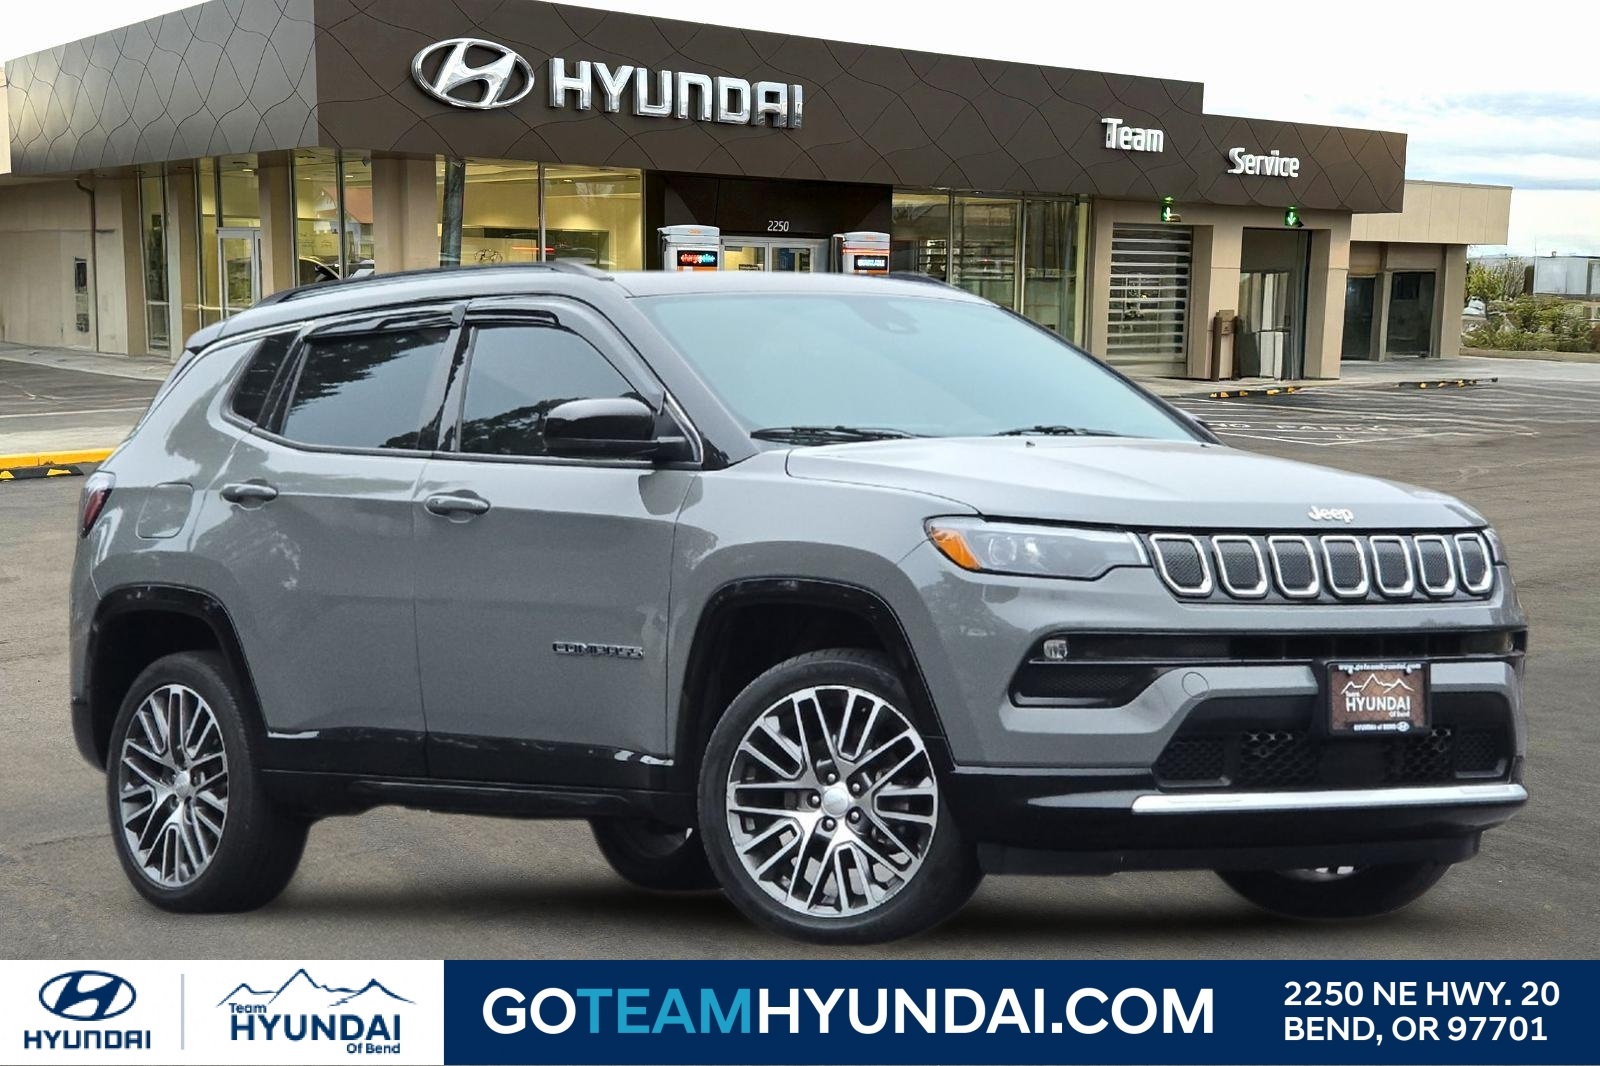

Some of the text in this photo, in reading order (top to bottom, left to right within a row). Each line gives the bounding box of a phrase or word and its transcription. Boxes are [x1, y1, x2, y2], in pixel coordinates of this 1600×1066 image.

[549, 57, 803, 129] HYUNDAI
[1101, 117, 1164, 152] Team
[1227, 147, 1300, 178] Service
[767, 220, 790, 232] 2250
[1307, 505, 1354, 524] Jeep
[552, 641, 644, 659] COMPASS
[1345, 696, 1411, 712] HYUNDAI
